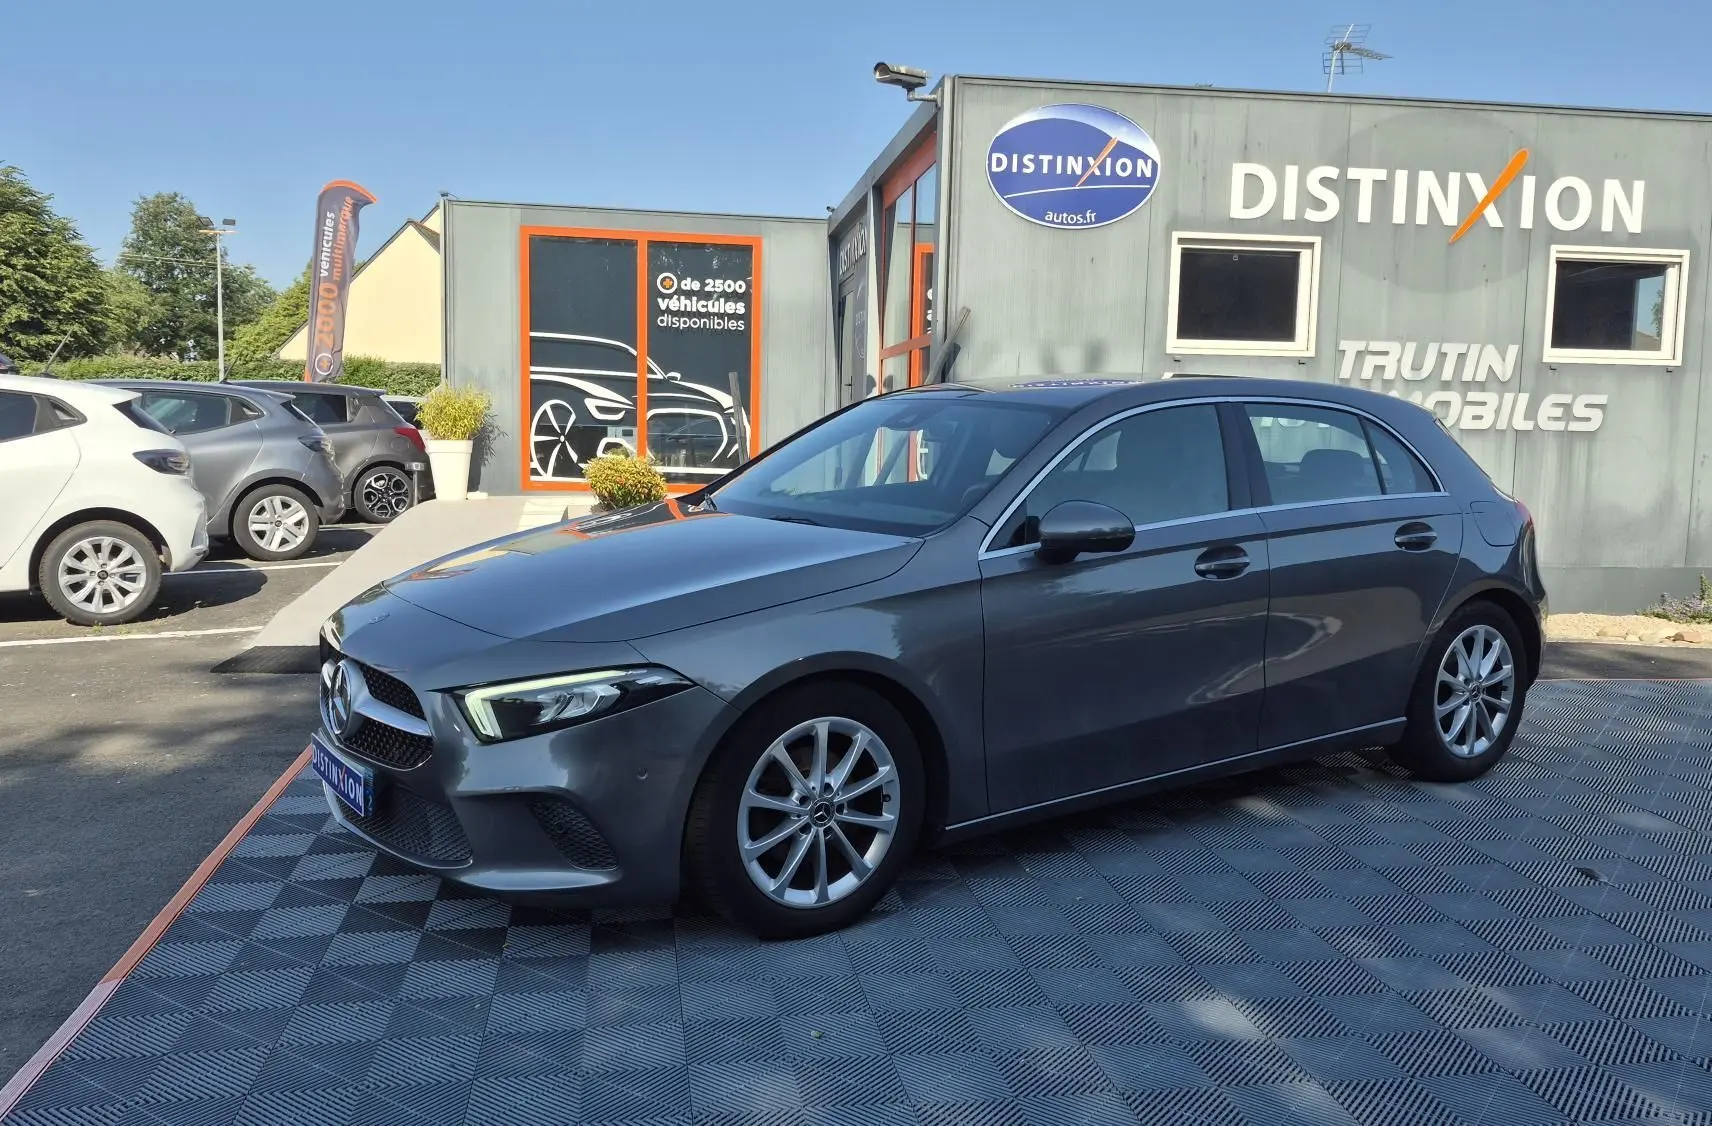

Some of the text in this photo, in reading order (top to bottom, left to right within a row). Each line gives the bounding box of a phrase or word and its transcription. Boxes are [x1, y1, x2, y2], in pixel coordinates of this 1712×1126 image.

[991, 138, 1153, 186] DISTINXION
[1229, 148, 1645, 243] DISTINXION
[1044, 209, 1097, 224] autos.fr
[680, 277, 747, 294] de 2500
[657, 294, 746, 315] véhicules
[657, 313, 745, 331] disponibles
[1338, 340, 1520, 383] TRUTIN
[312, 744, 363, 807] DISTINXION
